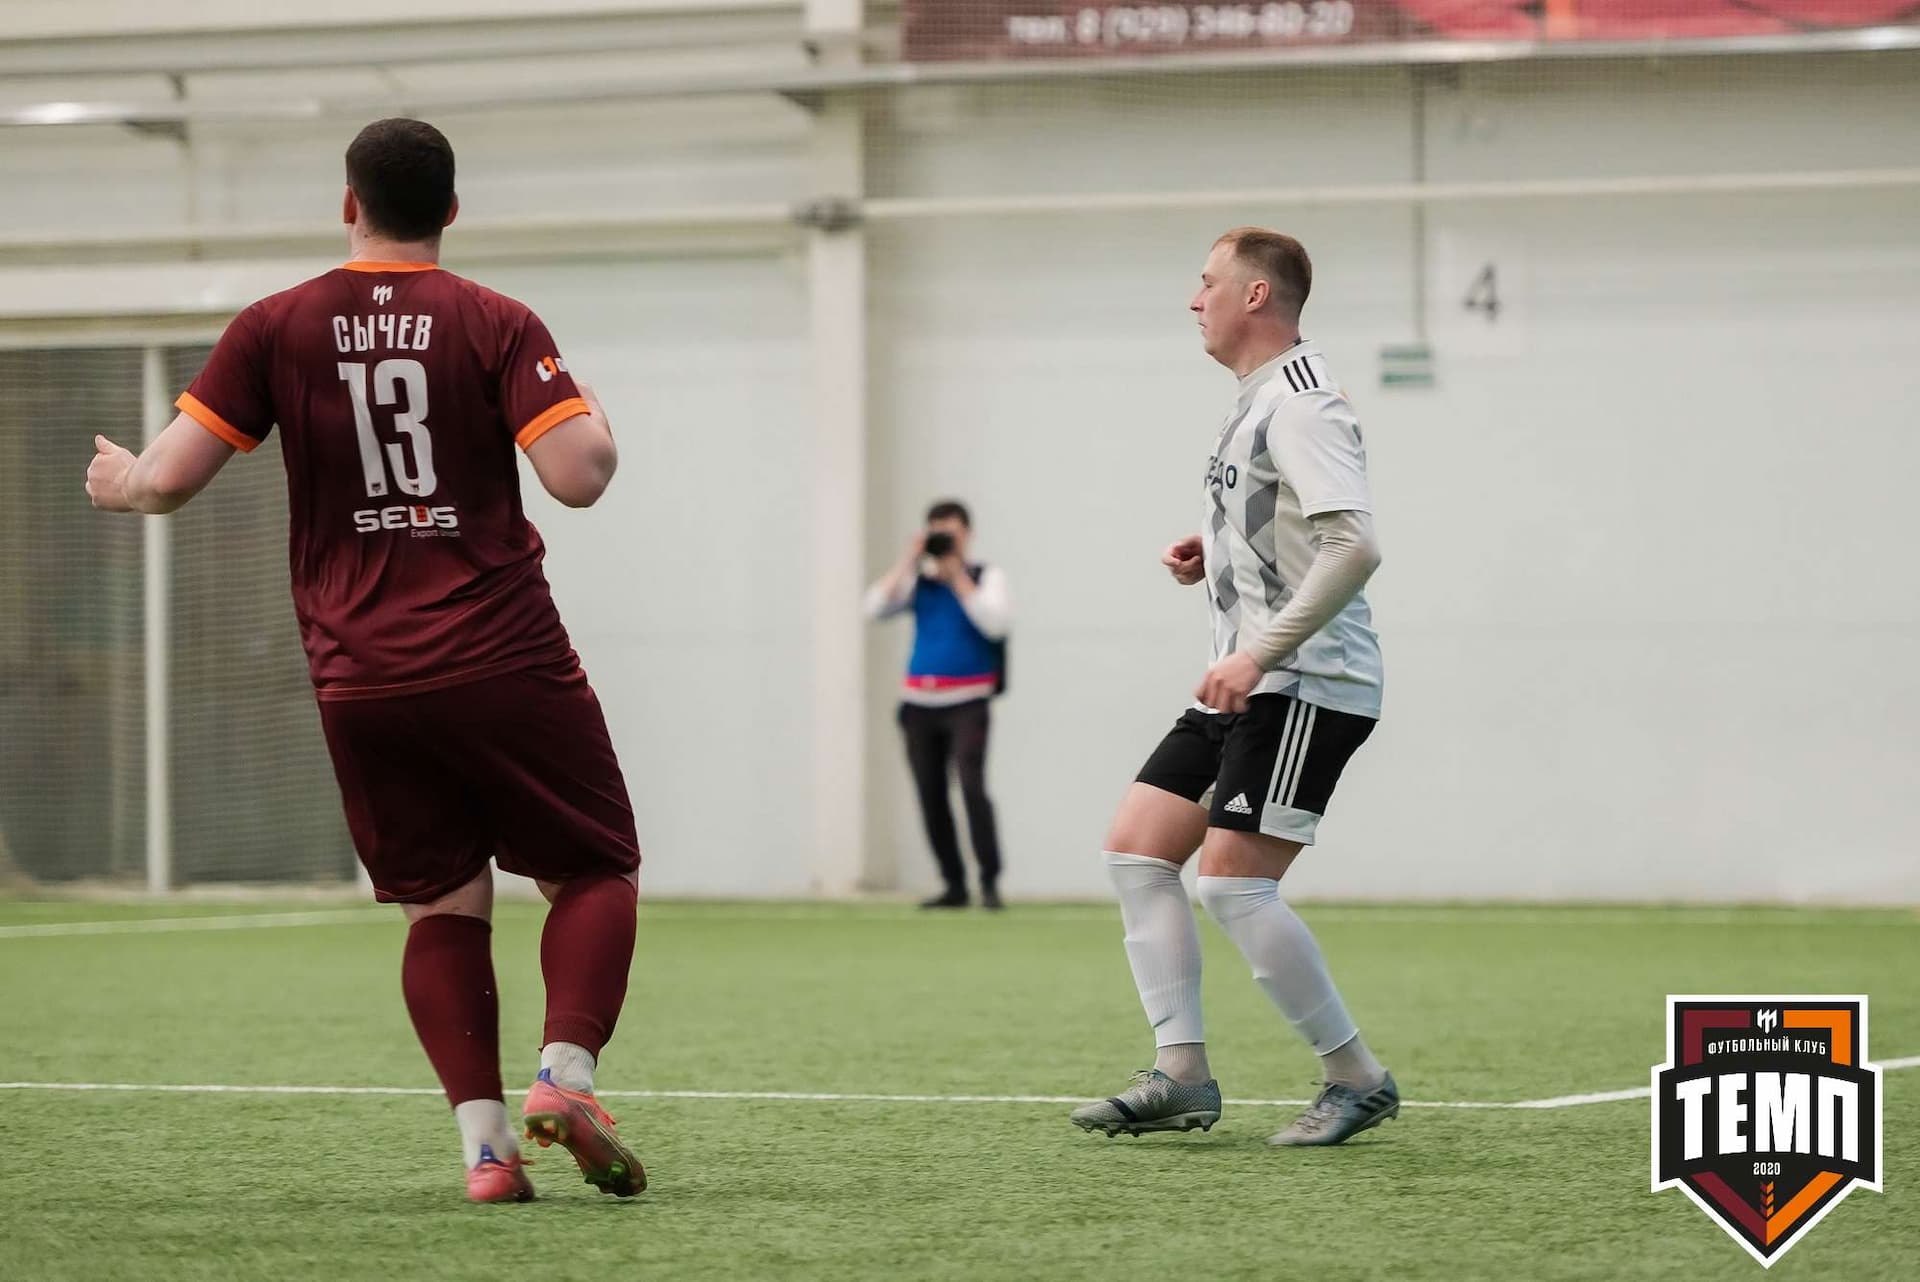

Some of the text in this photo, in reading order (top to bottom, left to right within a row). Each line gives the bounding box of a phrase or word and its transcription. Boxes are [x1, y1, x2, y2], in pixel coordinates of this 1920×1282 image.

[1075, 8, 1099, 45] 8
[1463, 261, 1501, 324] 4
[332, 314, 433, 353] СЫЧЕВ
[338, 359, 437, 498] 13
[353, 505, 459, 533] SEUS
